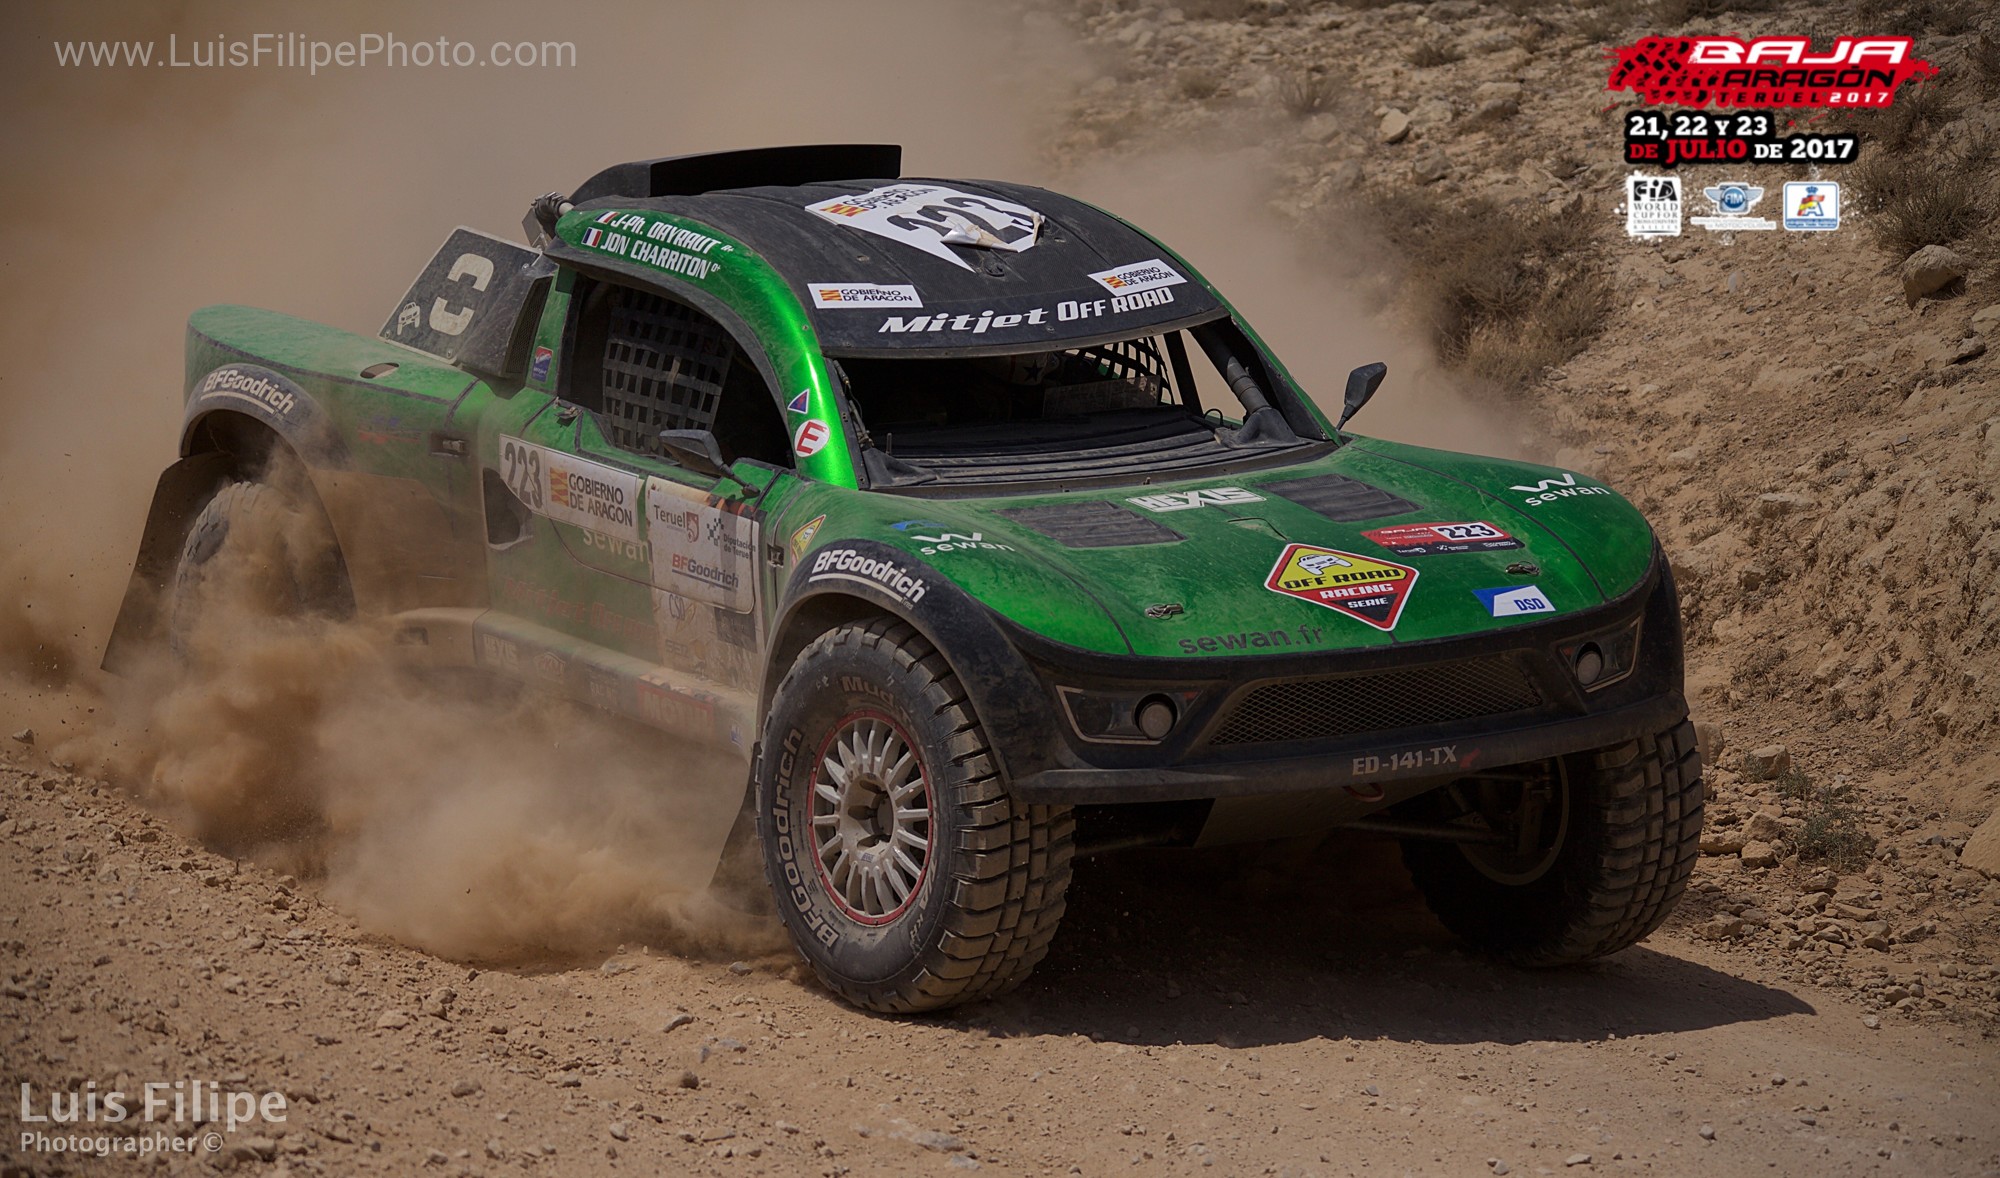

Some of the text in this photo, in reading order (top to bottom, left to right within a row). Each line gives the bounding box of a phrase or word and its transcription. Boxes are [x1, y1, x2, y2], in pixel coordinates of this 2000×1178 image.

[600, 231, 631, 256] JON
[630, 239, 711, 280] CHARRITON
[1117, 266, 1161, 280] GOBIERNO
[1139, 271, 1175, 284] ARAGON
[841, 288, 902, 296] GOBIERNO
[878, 307, 1050, 334] Mitjet
[1110, 286, 1175, 314] ROAD
[203, 369, 296, 414] BFGoodrich
[796, 421, 827, 455] E
[504, 441, 543, 510] 223
[568, 472, 624, 506] GOBIERNO
[1524, 483, 1611, 507] sewan
[570, 494, 633, 528] DE ARAGON
[653, 504, 686, 529] Teruel
[1437, 524, 1496, 539] 223
[919, 540, 1015, 556] sewan
[671, 553, 739, 589] BFGoodrich
[811, 549, 926, 604] BFGoodrich
[1284, 569, 1402, 589] OFF ROAD
[1320, 583, 1394, 600] RACING
[1347, 597, 1389, 609] SERIE
[1513, 597, 1546, 612] DSD
[1178, 623, 1323, 655] sewan.fr
[1352, 745, 1457, 776] ED-141-TX
[773, 728, 840, 948] BFGoodrich
